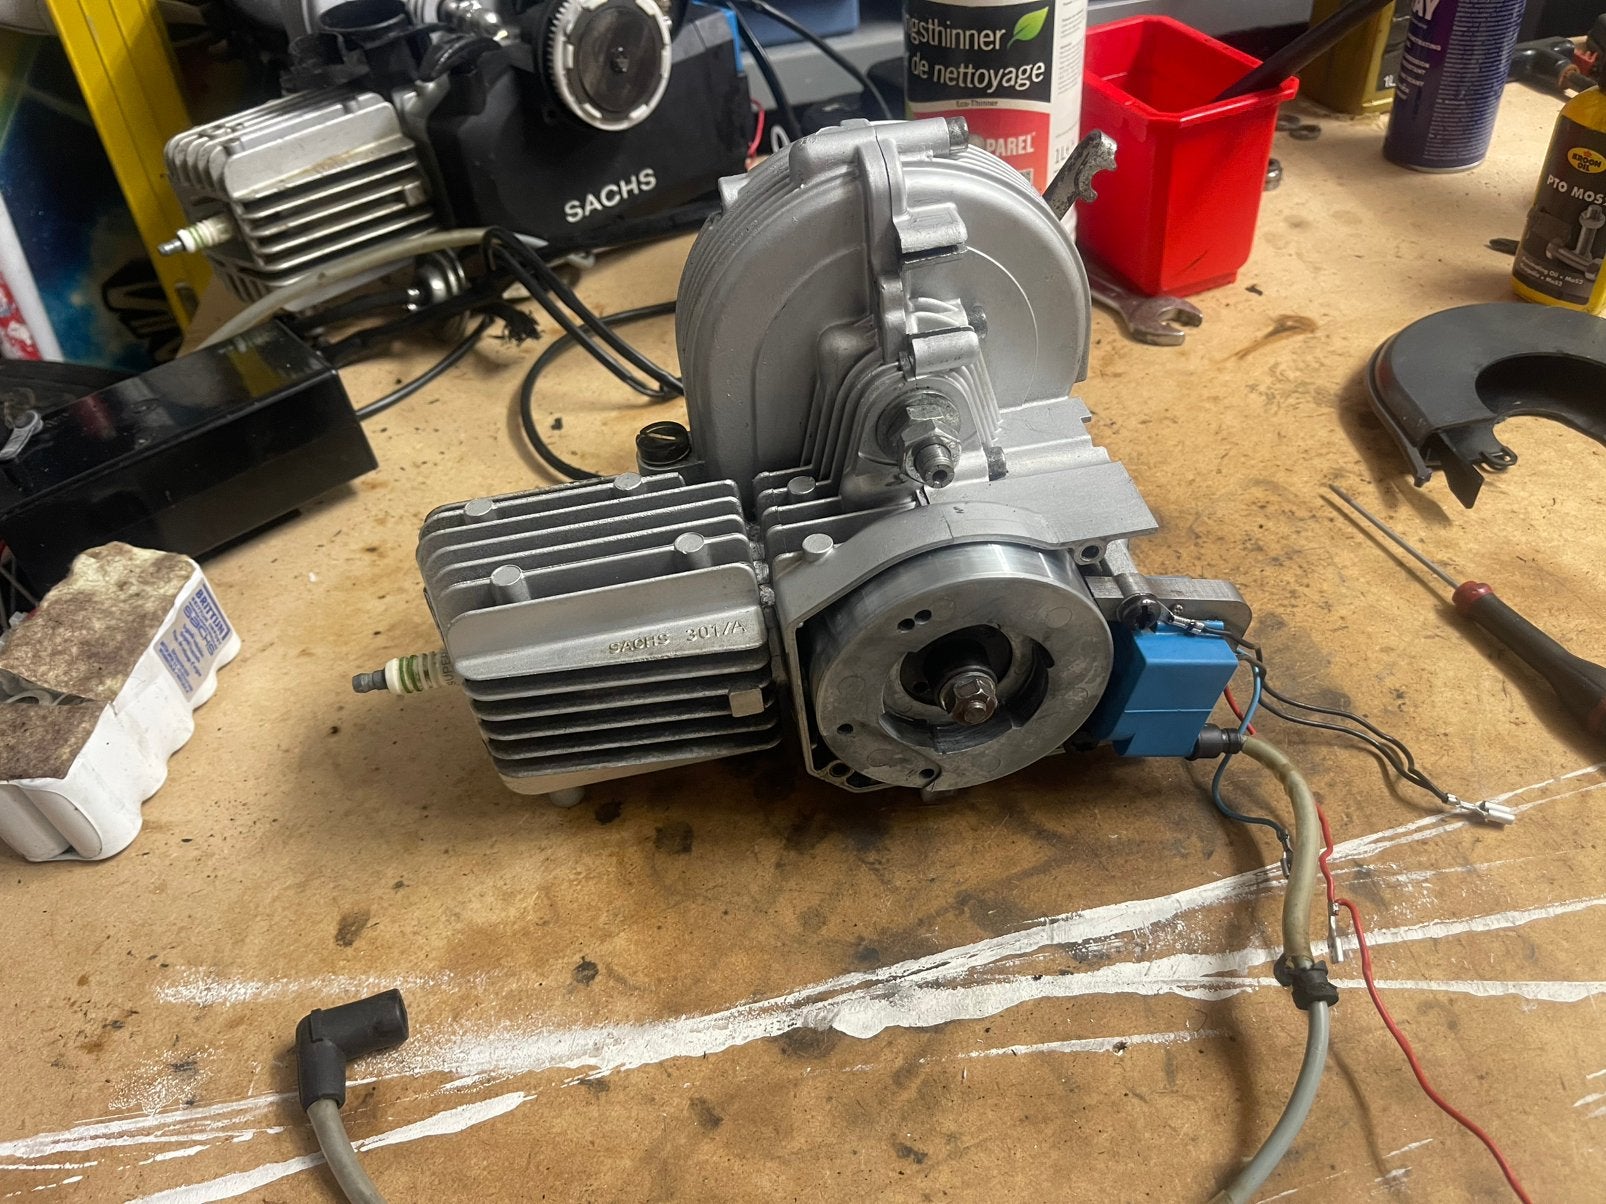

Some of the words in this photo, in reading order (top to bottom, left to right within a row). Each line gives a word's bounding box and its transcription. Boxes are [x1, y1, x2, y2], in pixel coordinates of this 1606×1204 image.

[1410, 0, 1439, 20] AY
[905, 15, 1006, 51] gsthinner
[911, 52, 929, 79] de
[934, 62, 1045, 93] nettoyage
[985, 135, 1034, 157] PAREL
[1572, 153, 1602, 168] KROON
[1577, 162, 1590, 172] OIL
[564, 168, 657, 224] SACHS
[1546, 174, 1568, 193] PTO
[1570, 186, 1606, 206] MOS
[608, 633, 671, 655] SACHS
[686, 619, 747, 643] 301/A
